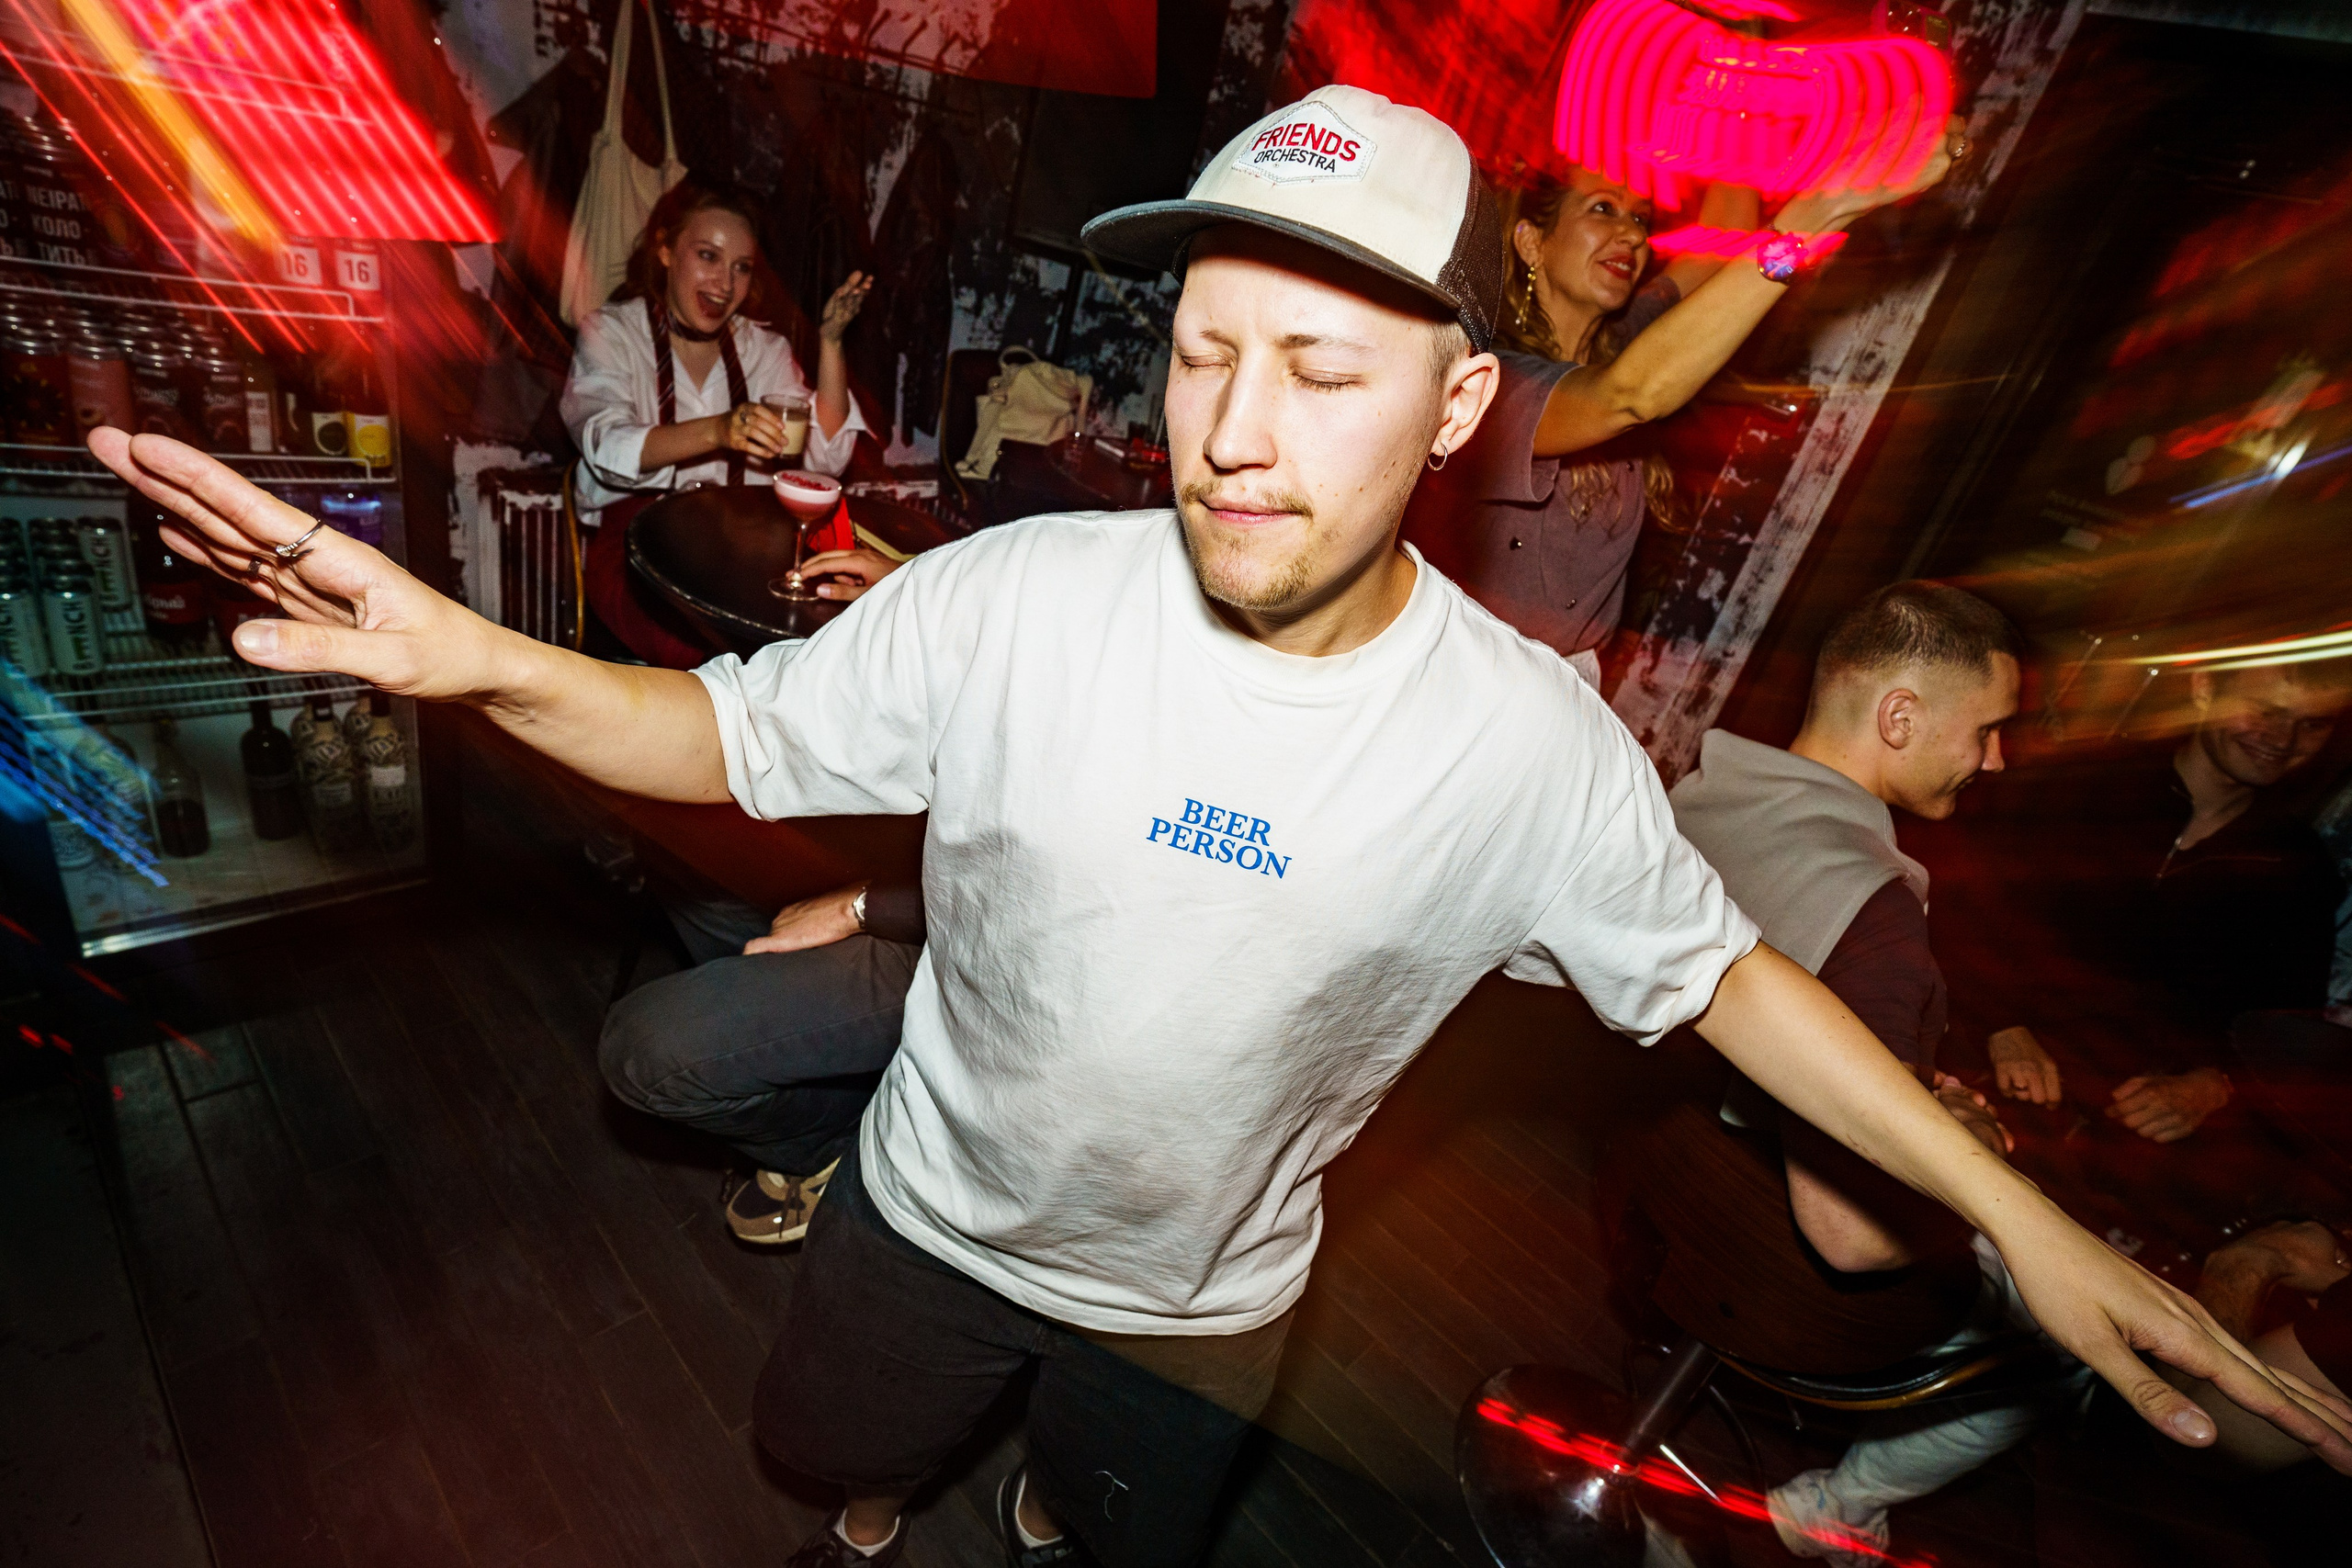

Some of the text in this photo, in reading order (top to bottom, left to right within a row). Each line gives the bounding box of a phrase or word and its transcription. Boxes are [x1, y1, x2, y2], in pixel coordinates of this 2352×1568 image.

[1251, 122, 1361, 162] FRIENDS
[1253, 148, 1336, 173] ORCHESTRA
[282, 251, 309, 276] 16
[345, 259, 370, 283] 16
[1179, 797, 1272, 847] BEER
[1146, 817, 1293, 879] PERSON
